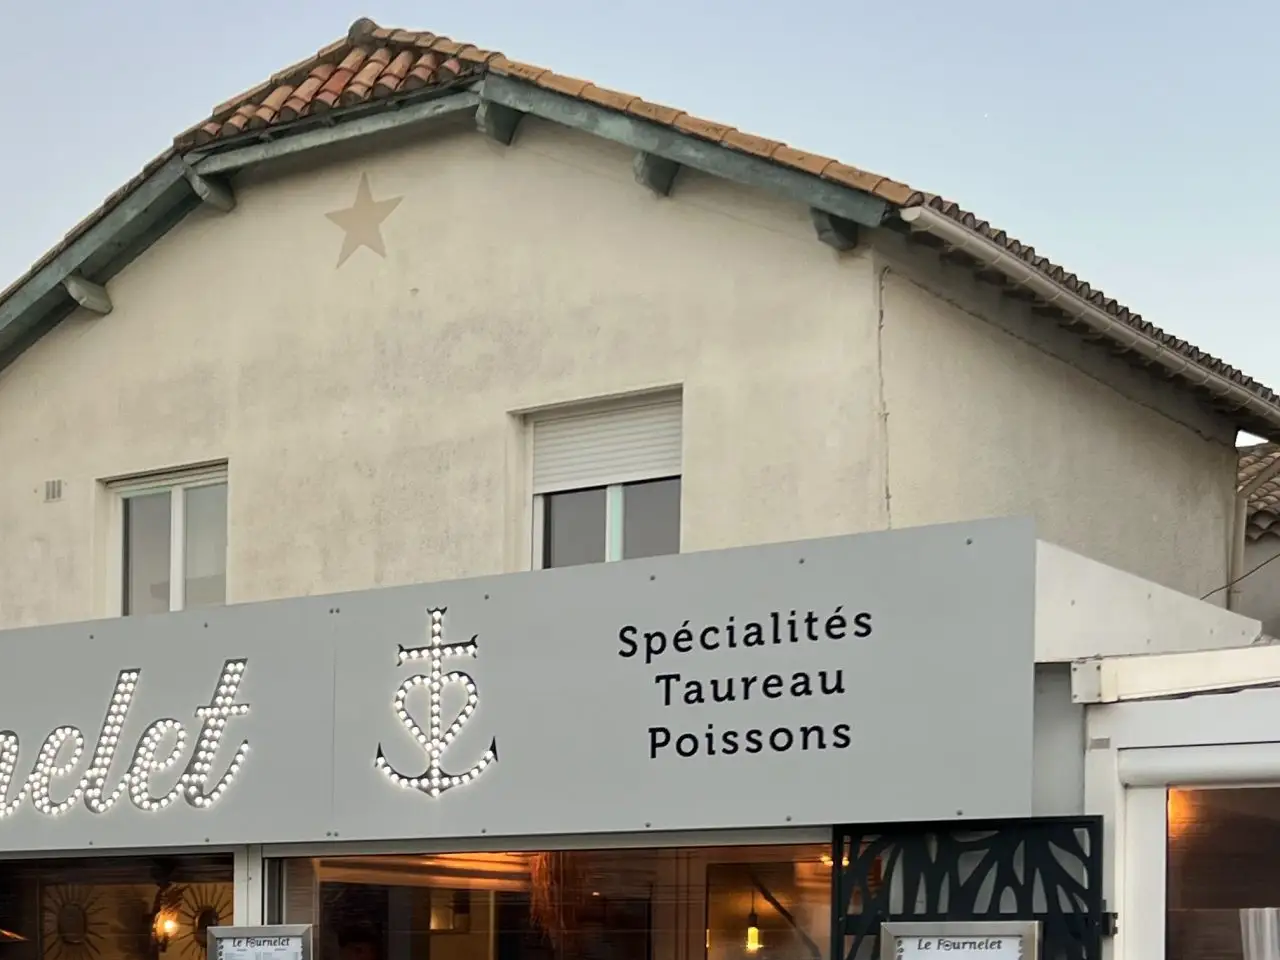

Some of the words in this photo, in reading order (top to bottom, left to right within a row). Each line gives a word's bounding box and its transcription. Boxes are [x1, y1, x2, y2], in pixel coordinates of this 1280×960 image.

[618, 605, 873, 665] Spécialités
[654, 668, 846, 707] Taureau
[647, 723, 852, 760] Poissons
[232, 937, 243, 947] Le
[245, 936, 290, 948] Fournelet
[917, 938, 932, 950] Le
[936, 937, 1002, 951] Fournelet
